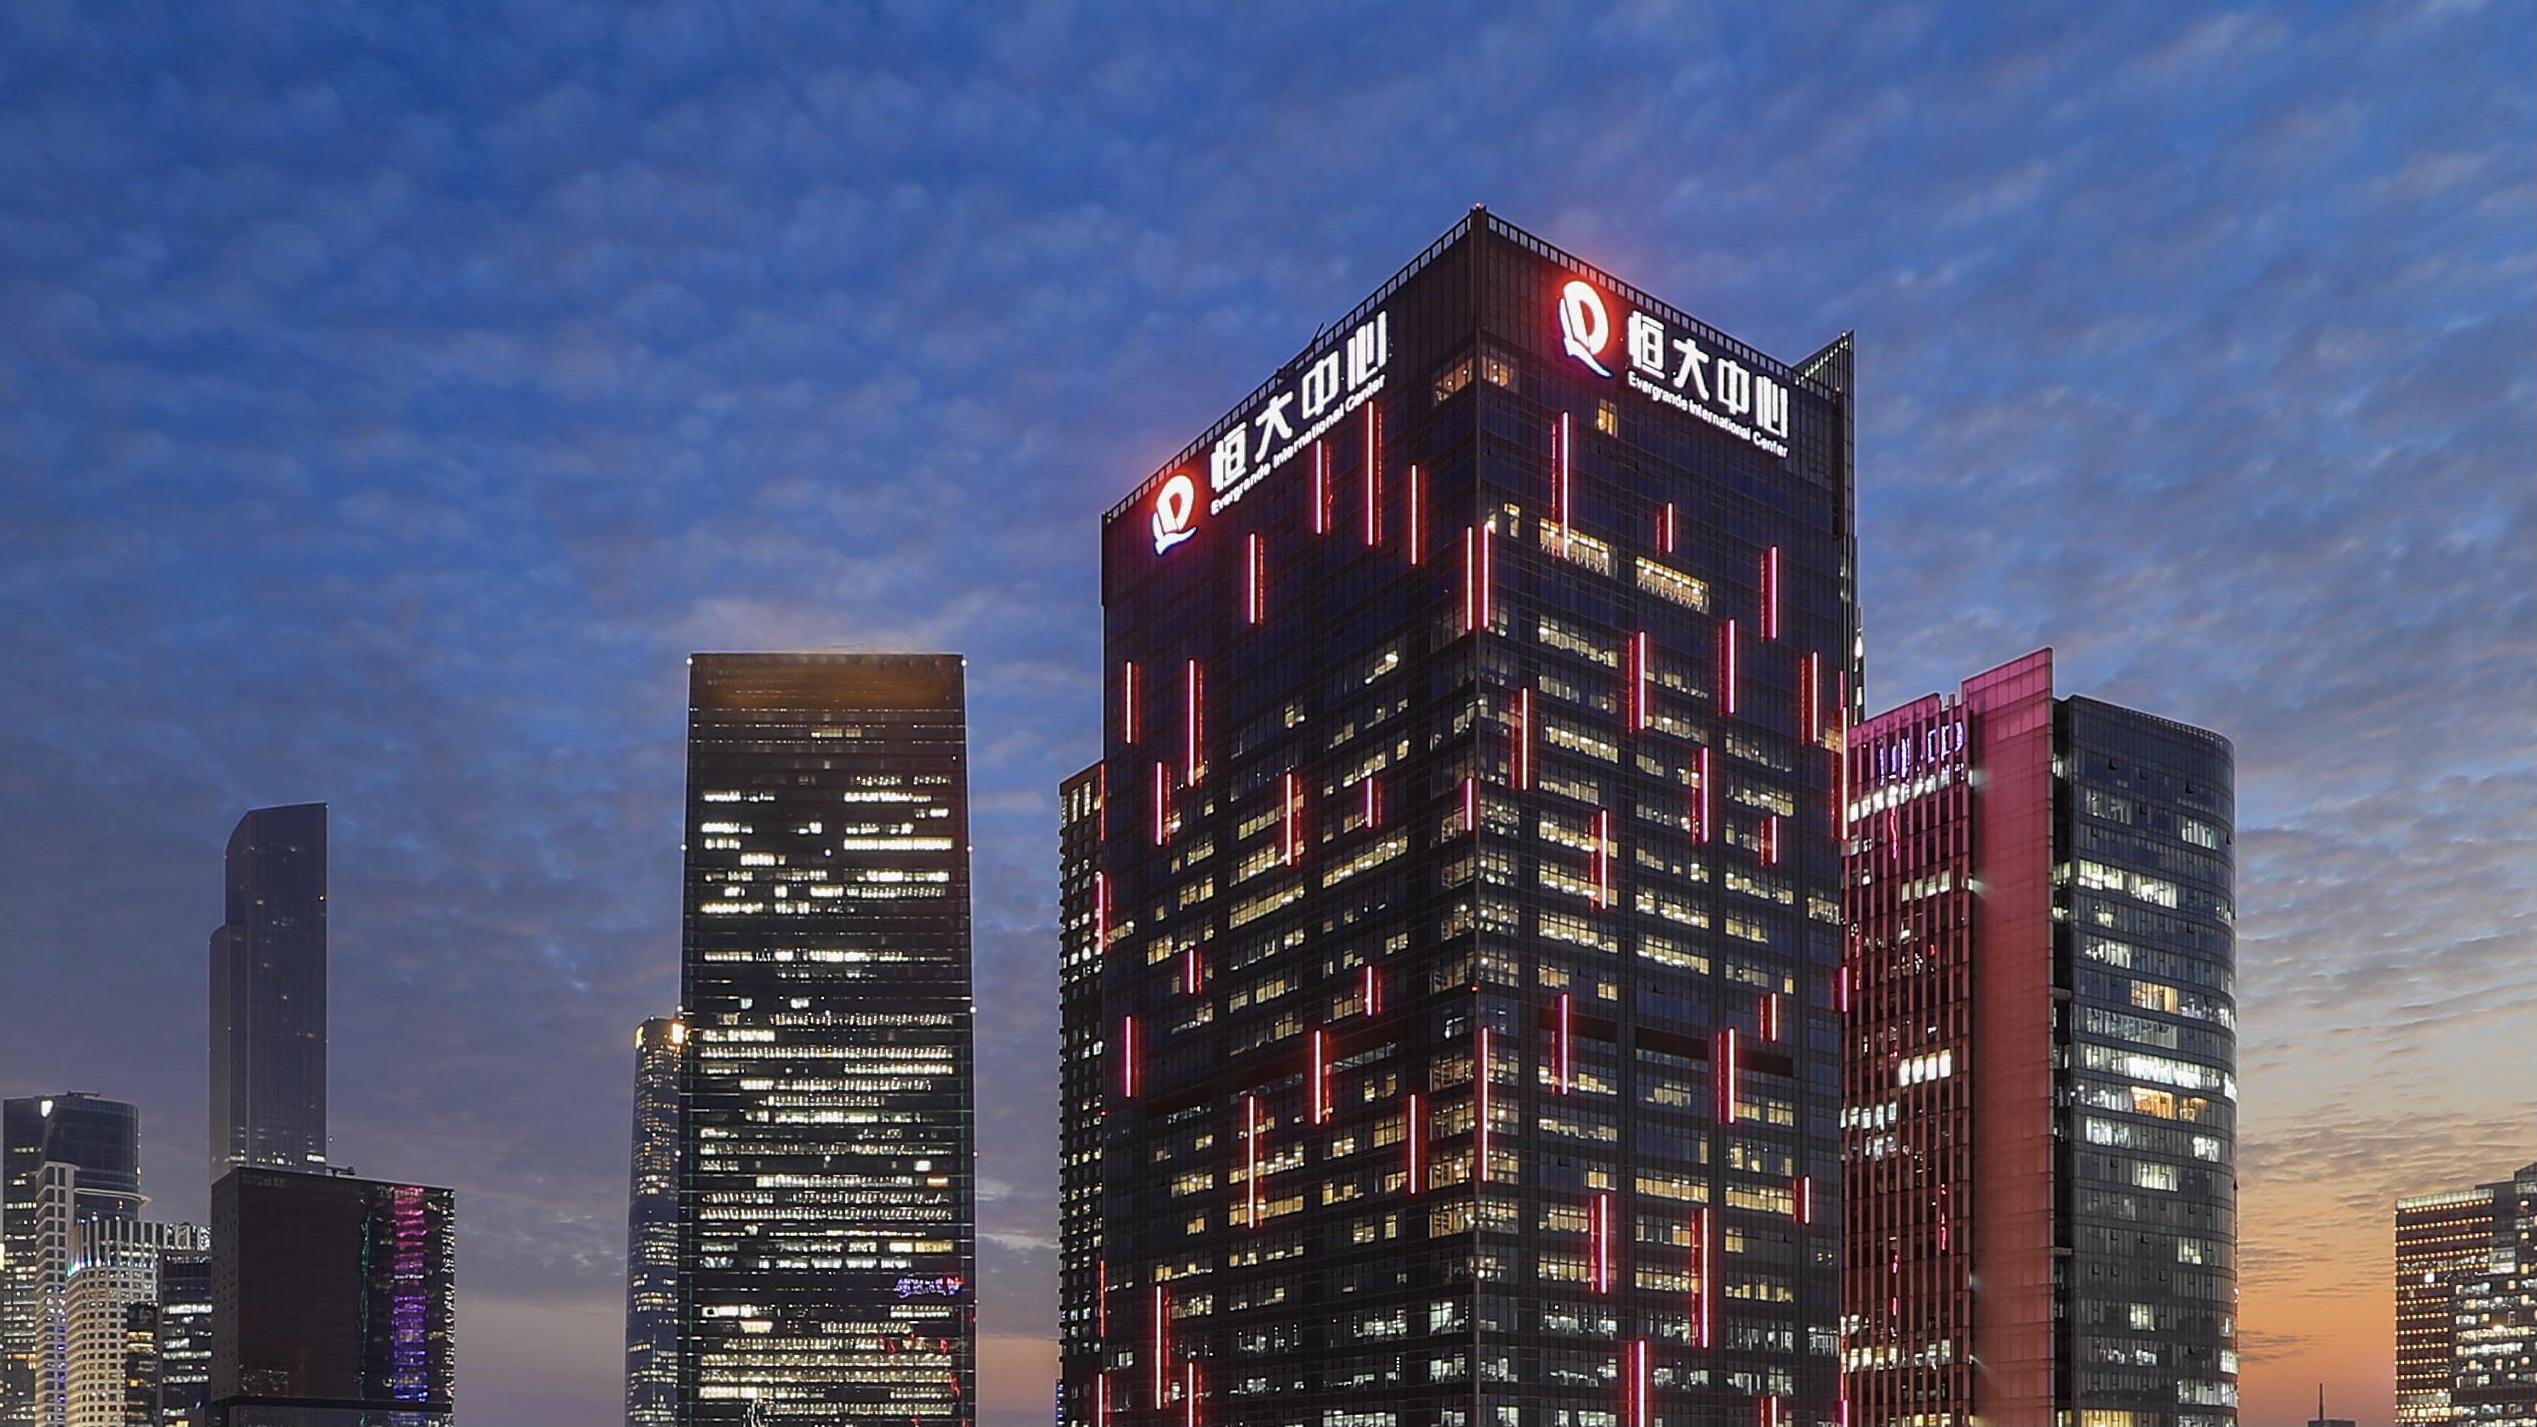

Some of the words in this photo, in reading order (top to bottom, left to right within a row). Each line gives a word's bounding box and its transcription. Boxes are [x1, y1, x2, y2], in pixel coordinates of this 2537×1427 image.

[1211, 311, 1386, 493] 恒大中心
[1628, 310, 1788, 438] 恒大中心
[1628, 371, 1688, 411] Evergrande
[1688, 400, 1750, 440] International
[1752, 431, 1788, 458] Center
[1210, 463, 1270, 515] Evergrande
[1273, 403, 1344, 468] International
[1345, 374, 1386, 412] Center
